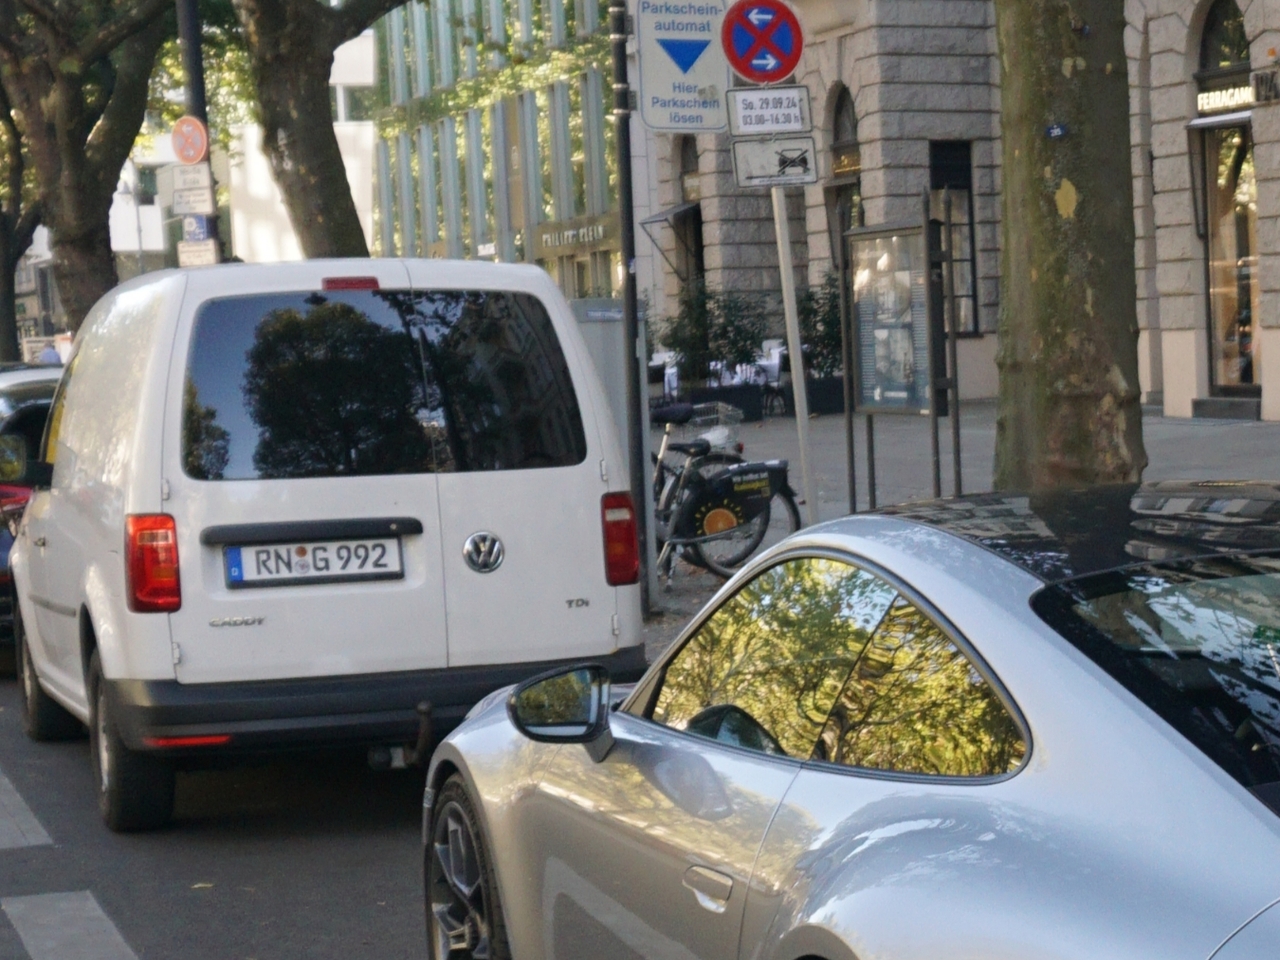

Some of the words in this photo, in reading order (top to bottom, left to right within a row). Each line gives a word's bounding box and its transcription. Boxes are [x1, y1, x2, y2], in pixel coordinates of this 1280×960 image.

[641, 1, 723, 15] Parkschein-
[654, 19, 711, 32] automat
[672, 82, 698, 93] Hier
[651, 96, 720, 109] Parkschein
[741, 98, 756, 110] So.
[759, 96, 797, 110] 29.09.24
[669, 112, 703, 124] lösen
[254, 548, 292, 576] RN
[311, 546, 330, 572] G
[336, 543, 388, 570] 992
[231, 567, 238, 576] D
